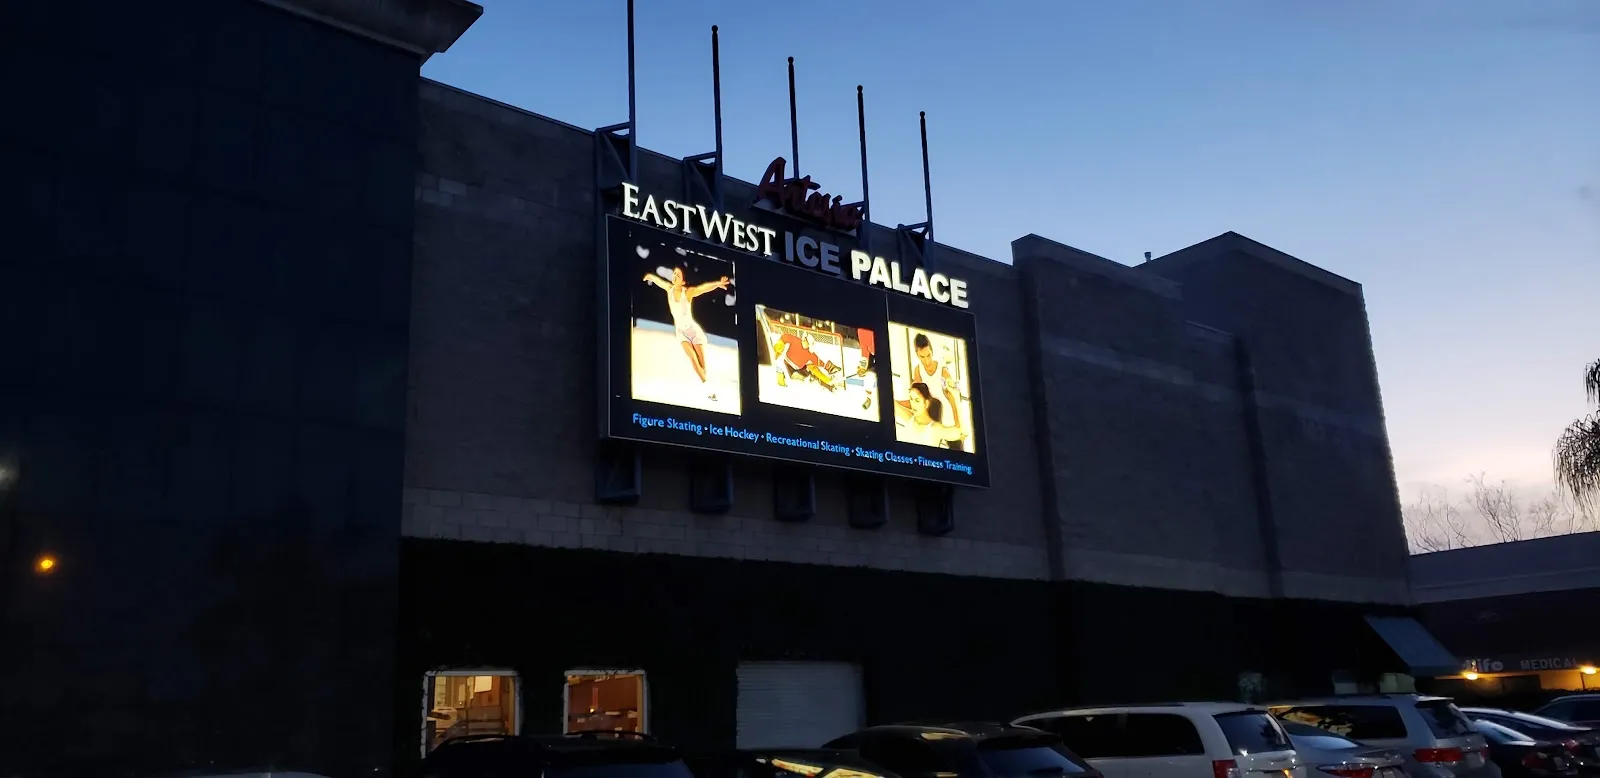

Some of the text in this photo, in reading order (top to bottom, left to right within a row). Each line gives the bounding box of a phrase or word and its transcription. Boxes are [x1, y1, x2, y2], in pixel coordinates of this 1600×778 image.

[785, 231, 841, 274] ICE
[851, 250, 969, 309] PALACE
[633, 413, 973, 475] Figure Skating Ice Hockey Recreational Skating Skating Classes Fitness Training
